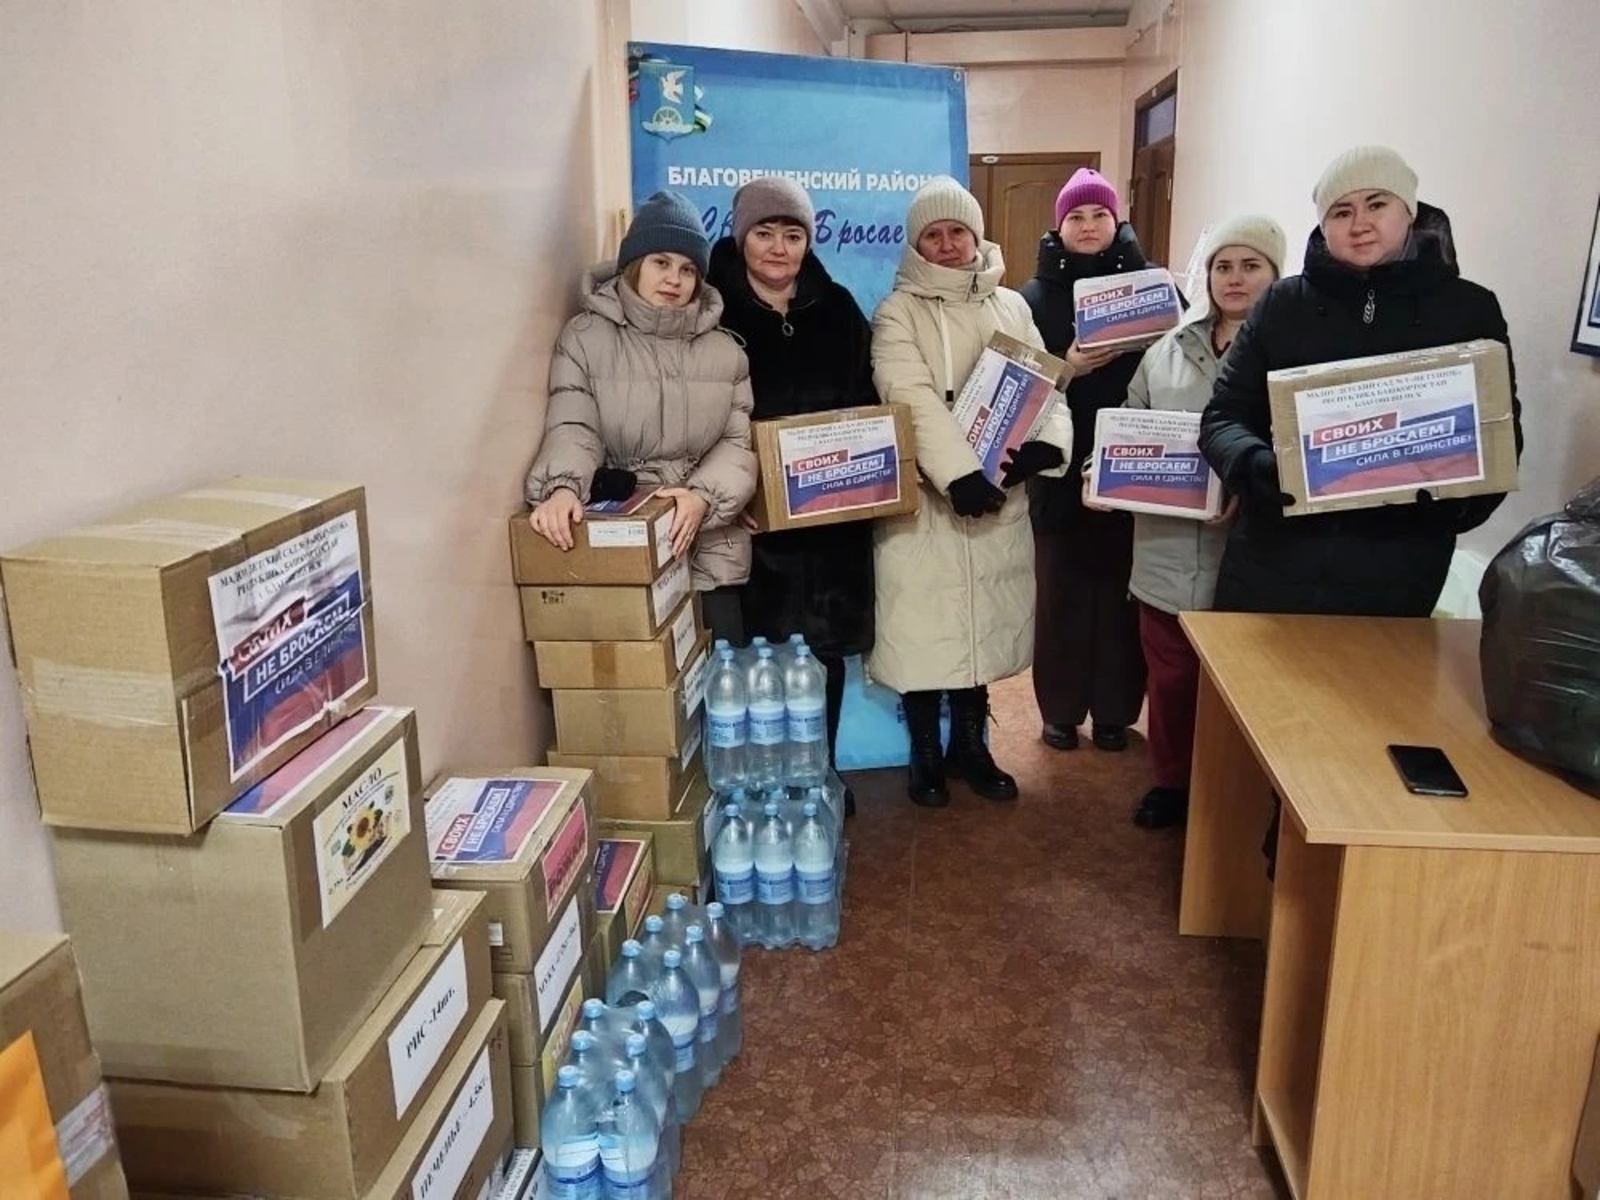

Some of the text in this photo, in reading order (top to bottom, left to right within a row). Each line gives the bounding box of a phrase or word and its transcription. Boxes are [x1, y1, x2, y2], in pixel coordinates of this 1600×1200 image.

[815, 209, 905, 253] Бросае
[1083, 287, 1124, 306] СВОИХ
[1092, 291, 1163, 316] НЕ БРОСАЕМ
[986, 383, 1014, 441] БРОСАЕМ
[969, 415, 986, 444] ОИХ
[1321, 417, 1384, 442] СВОИХ
[1335, 423, 1445, 456] НЕ БРОСАЕМ
[797, 452, 840, 471] СВОИХ
[1113, 446, 1155, 457] СВОИХ
[1356, 434, 1472, 467] СИЛА В ЕДИНСТВЕ!
[807, 459, 880, 483] НЕ БРОСАЕМ
[1119, 461, 1192, 472] НЕ БРОСАЕМ
[1130, 474, 1153, 482] СИЛА
[821, 480, 844, 491] СИЛА
[256, 655, 276, 685] НЕ
[280, 605, 347, 667] БРОСАЕМ
[342, 767, 382, 809] МАСЛО
[441, 816, 471, 850] СВОИХ
[466, 831, 481, 844] НЕ
[406, 1020, 426, 1059] РИС
